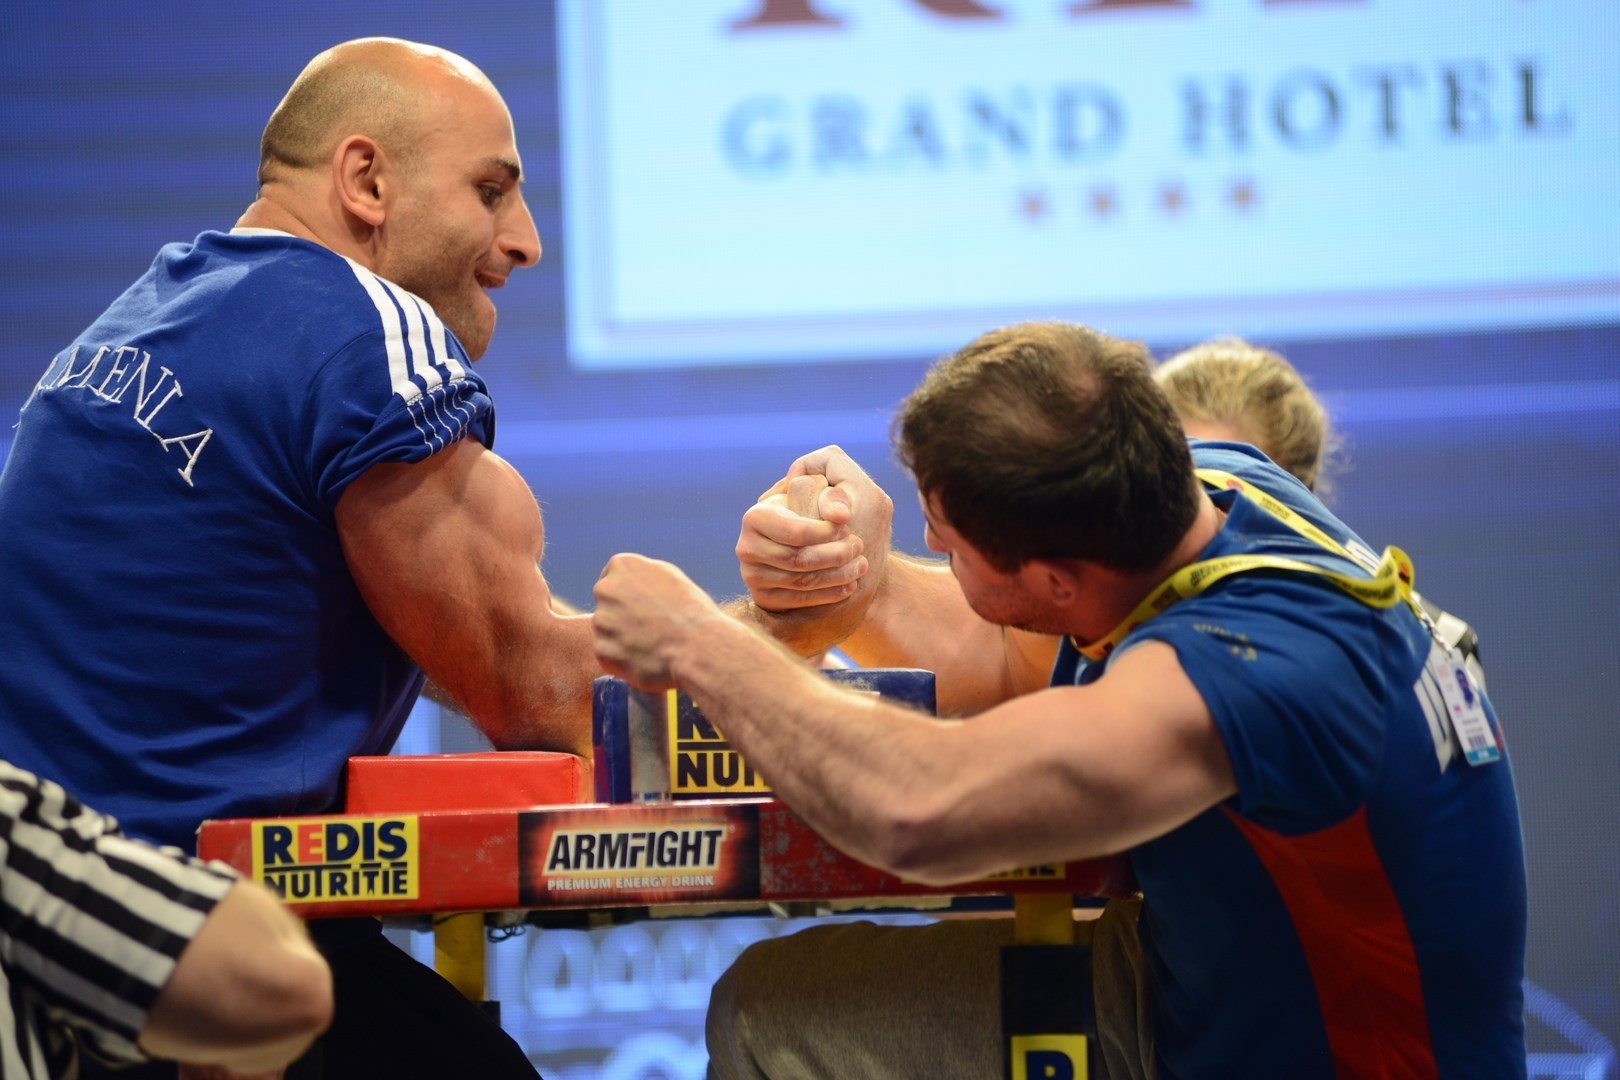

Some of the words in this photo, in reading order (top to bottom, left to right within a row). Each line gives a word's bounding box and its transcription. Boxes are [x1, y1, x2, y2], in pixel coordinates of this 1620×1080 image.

[721, 80, 1128, 180] GRAND
[1177, 55, 1574, 156] HOTEL
[262, 821, 408, 865] REDIS
[547, 829, 724, 871] ARMFIGHT
[547, 878, 612, 891] PREMIUM
[616, 876, 667, 889] ENERGY
[671, 874, 715, 887] DRINK
